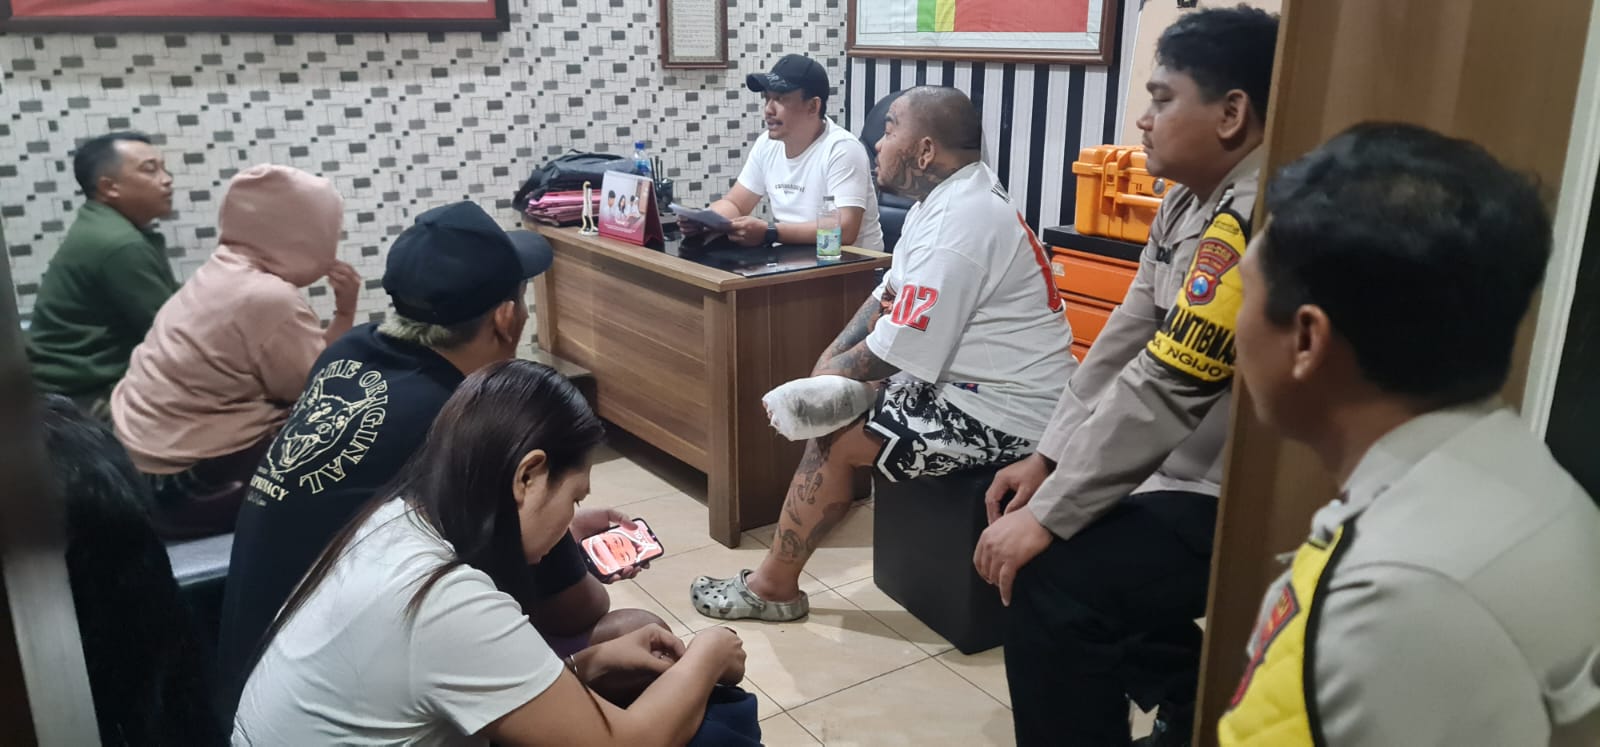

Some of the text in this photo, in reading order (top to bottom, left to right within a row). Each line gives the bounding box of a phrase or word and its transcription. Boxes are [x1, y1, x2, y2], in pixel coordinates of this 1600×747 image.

[890, 283, 939, 332] 02
[1166, 346, 1222, 377] NGIJO
[299, 370, 389, 495] ORIGINAL
